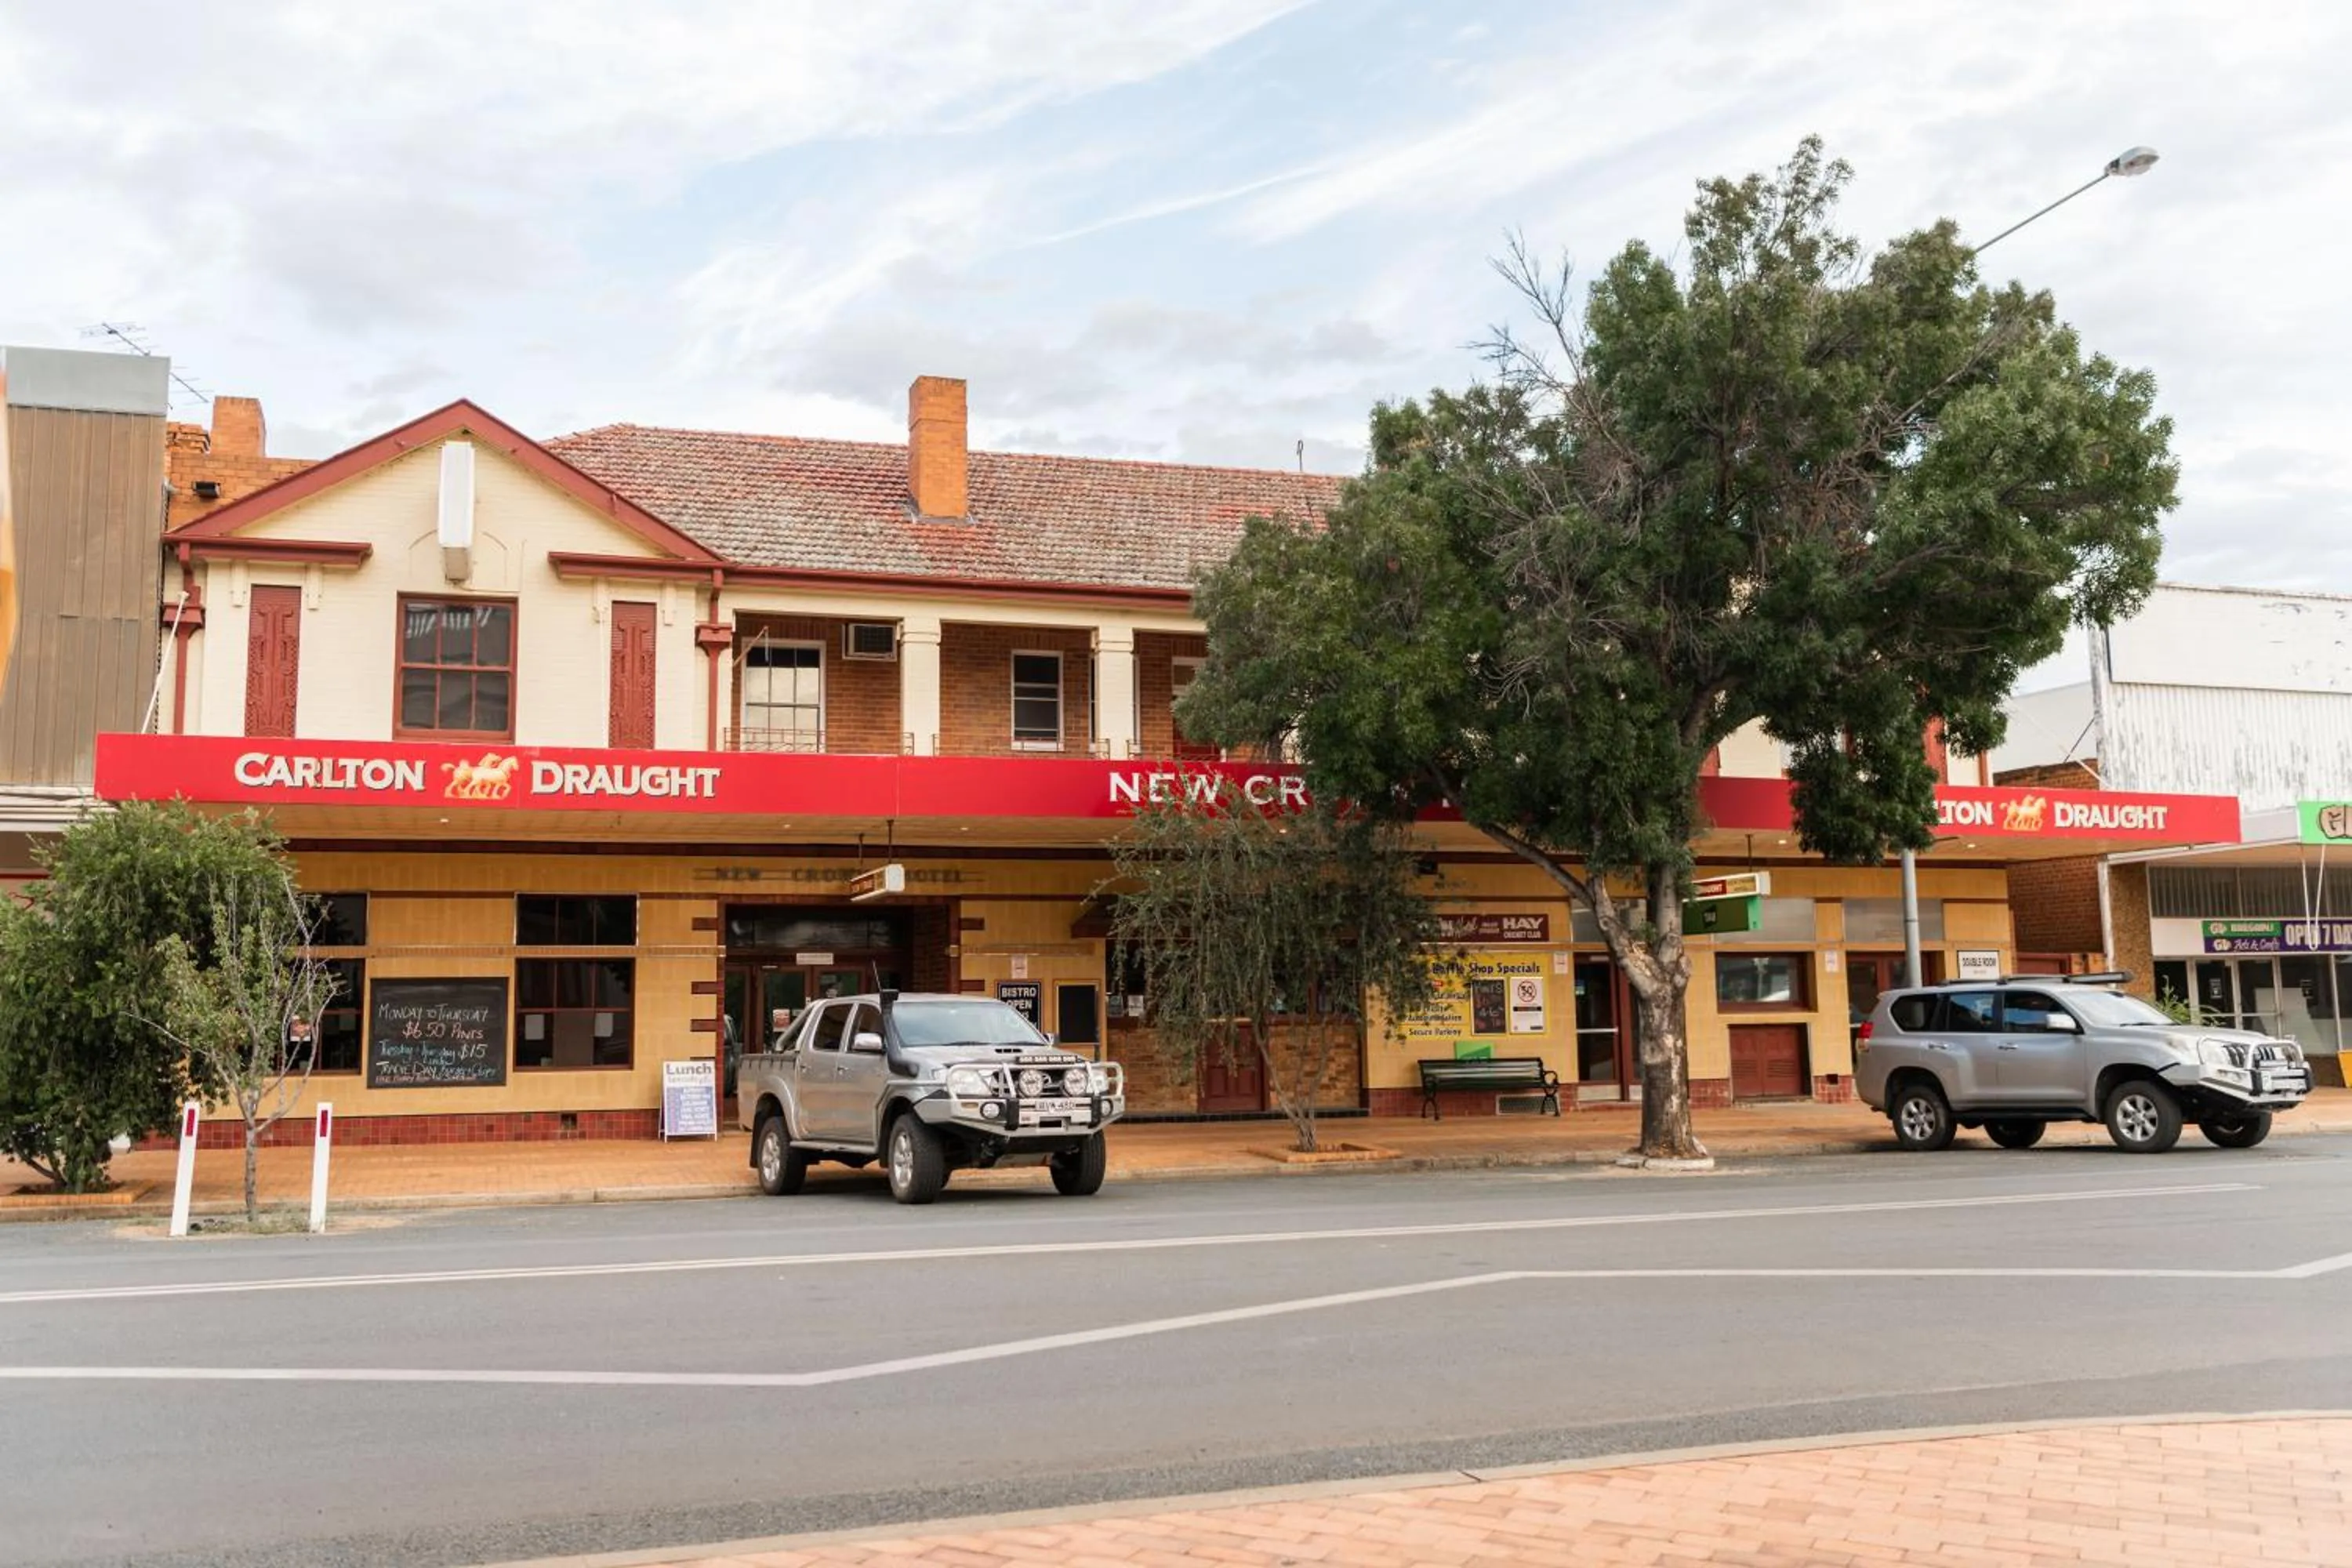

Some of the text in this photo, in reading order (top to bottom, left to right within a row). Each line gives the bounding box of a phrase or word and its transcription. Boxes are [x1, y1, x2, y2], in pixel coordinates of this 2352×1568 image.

[234, 753, 721, 798] CARLTON DRAUGHT
[1109, 771, 1223, 804] NEW
[2053, 801, 2168, 829] DRAUGHT
[1502, 916, 1544, 929] HAY
[2322, 924, 2330, 946] 7
[1469, 961, 1494, 975] Shop
[1497, 961, 1541, 975] Specials
[1001, 987, 1036, 998] BISTRO
[378, 1003, 423, 1021] MONDAY
[458, 1044, 489, 1061] $15
[666, 1062, 712, 1075] Lunch
